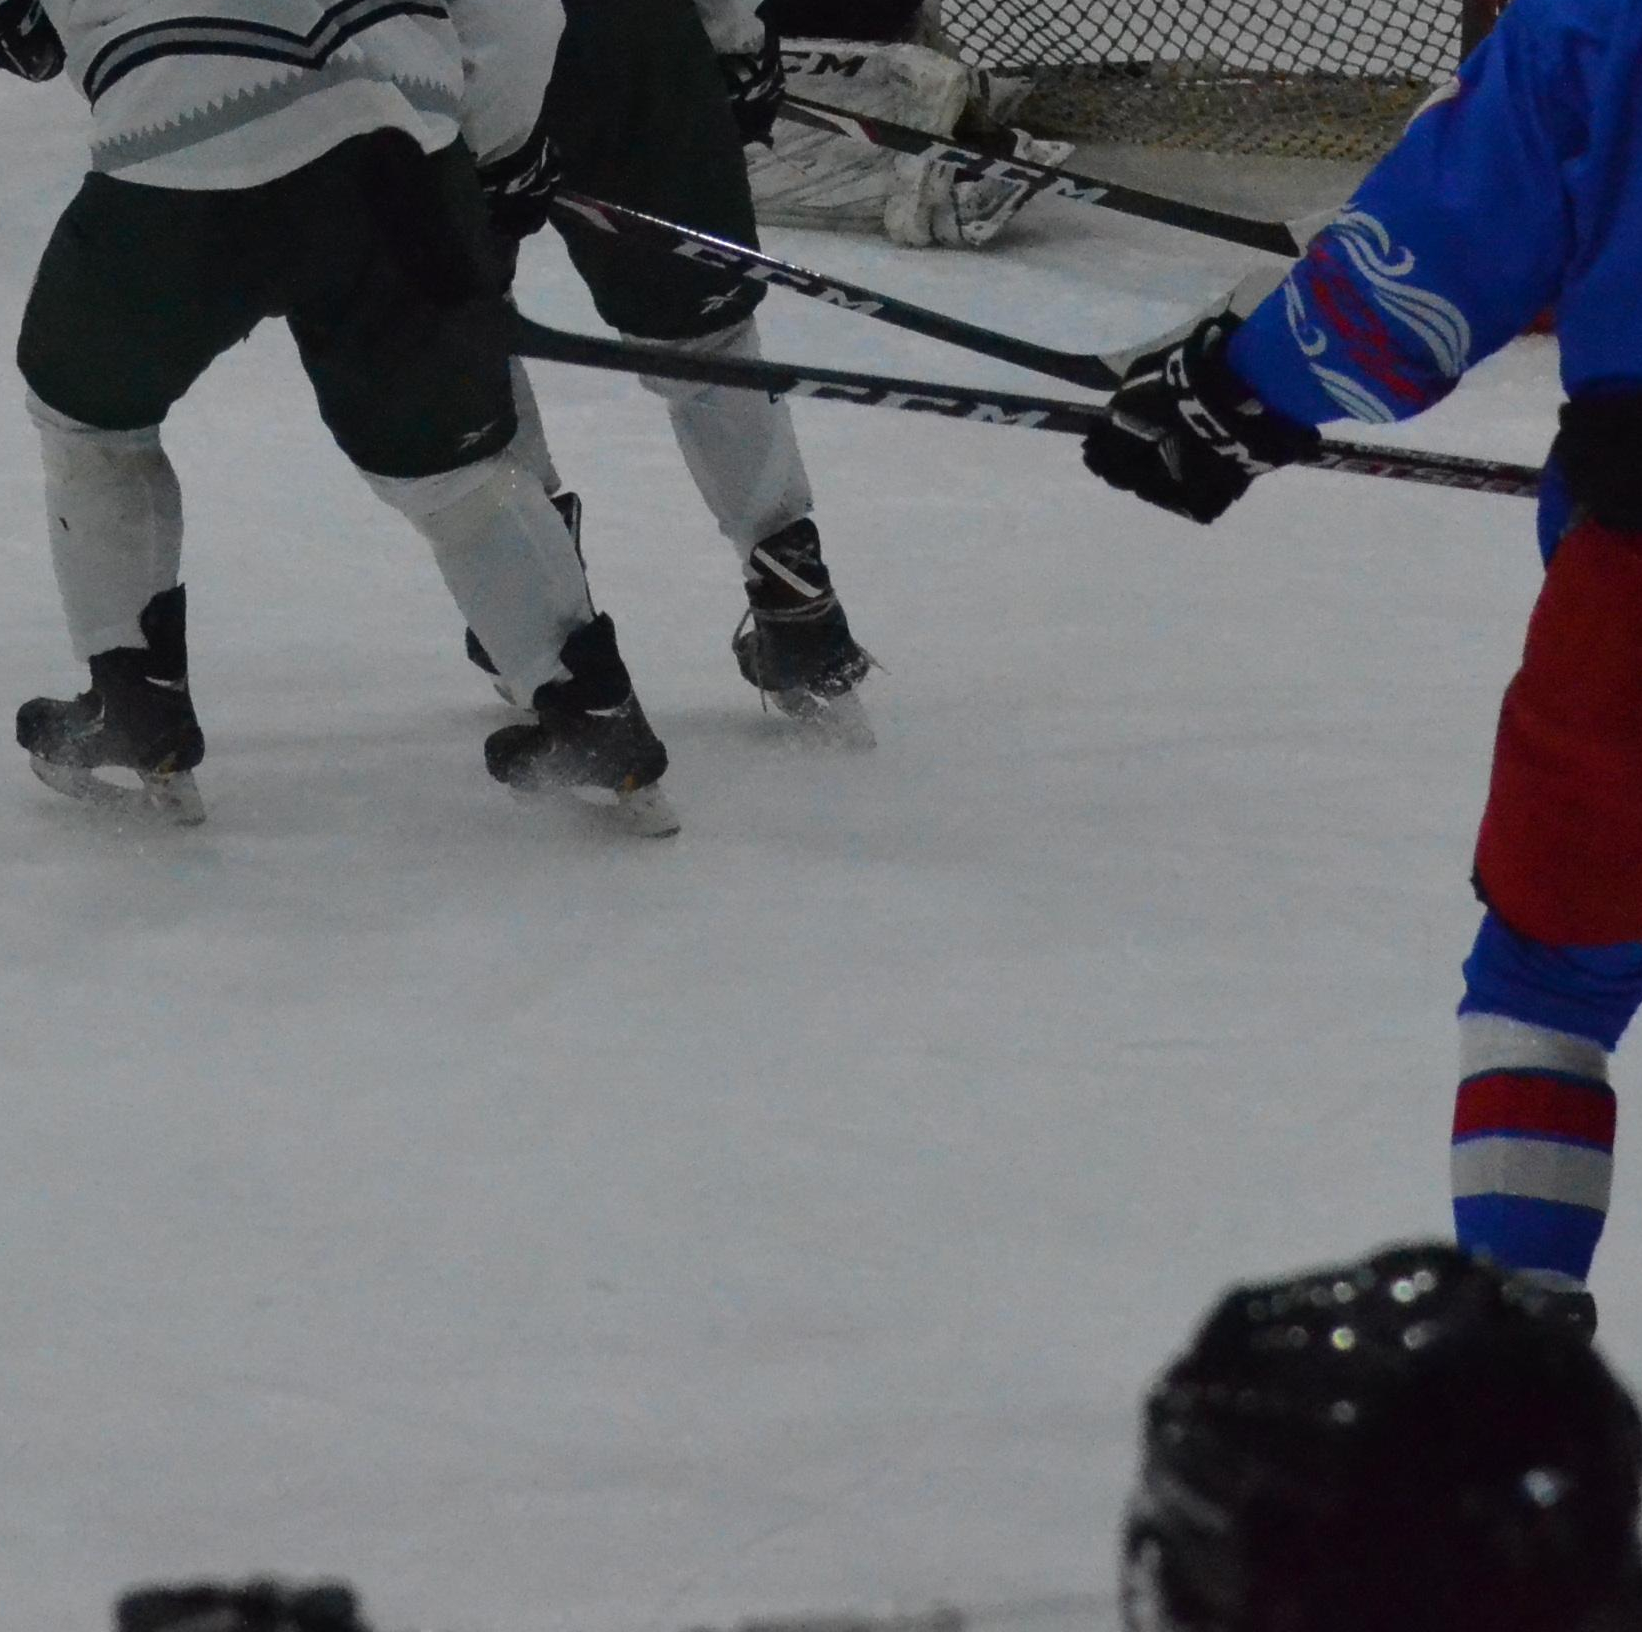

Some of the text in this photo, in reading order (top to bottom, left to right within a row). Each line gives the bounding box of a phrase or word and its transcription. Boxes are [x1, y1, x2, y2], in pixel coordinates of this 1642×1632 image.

[915, 141, 1110, 206] CCM
[672, 237, 885, 317] CCM
[782, 376, 1051, 430] CCM
